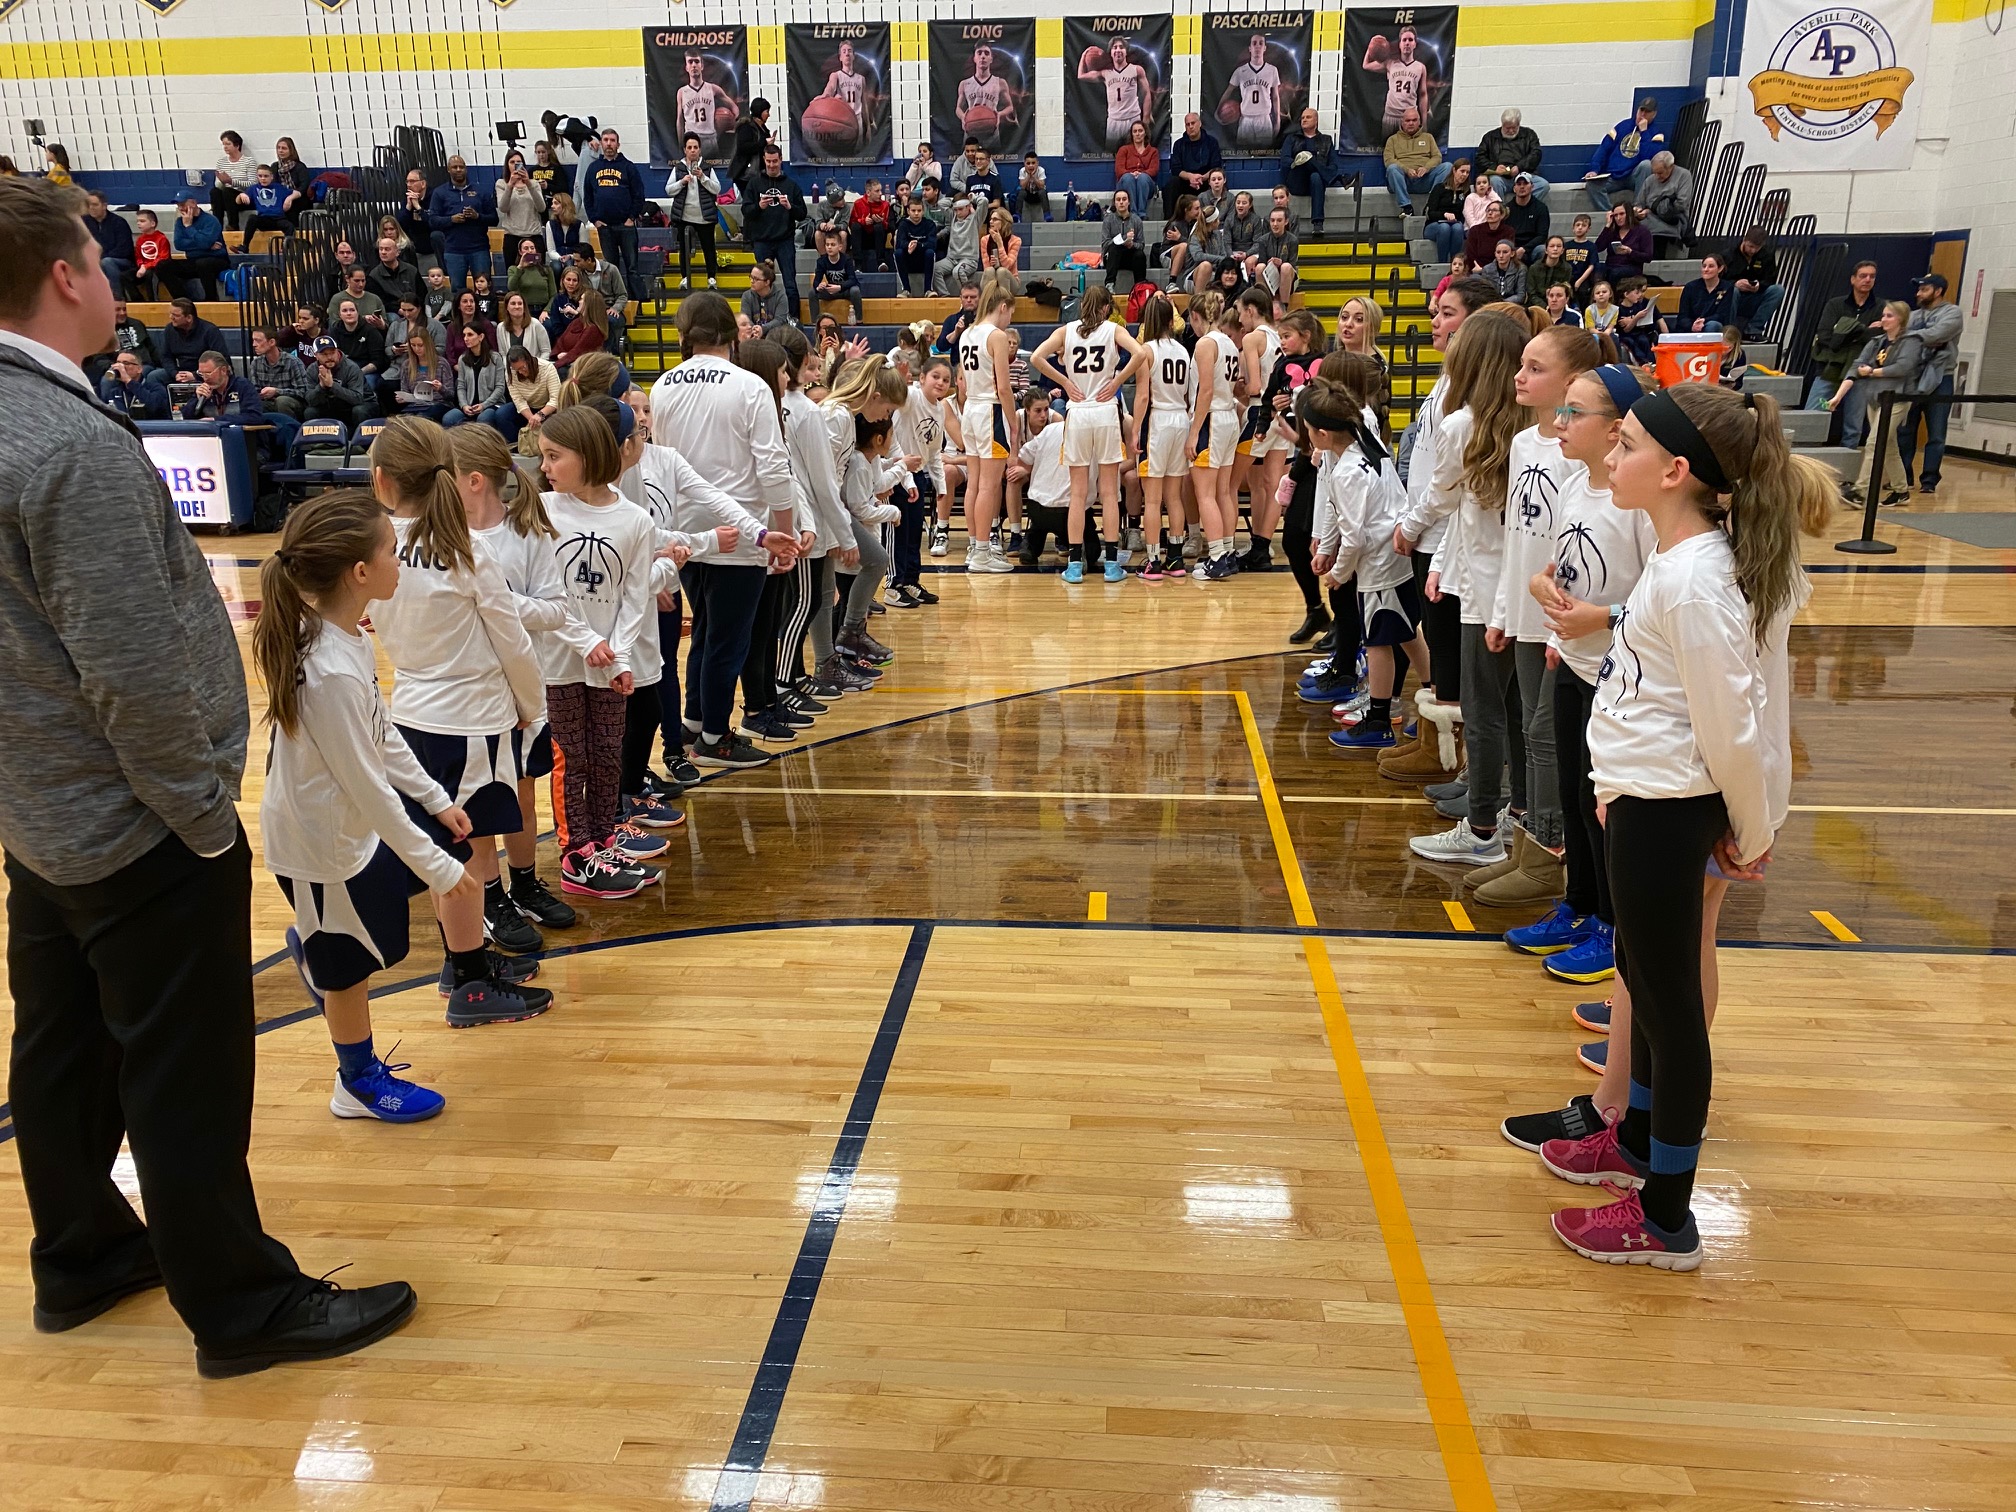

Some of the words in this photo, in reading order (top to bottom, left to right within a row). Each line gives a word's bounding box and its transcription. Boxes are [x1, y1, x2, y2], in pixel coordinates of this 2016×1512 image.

[1092, 17, 1143, 31] MORIN
[1212, 13, 1304, 28] PASCARELLA
[1394, 10, 1414, 24] RE
[813, 25, 867, 38] LETTKO
[962, 25, 1003, 39] LONG
[1794, 12, 1841, 38] AVERILL
[1849, 12, 1878, 35] PARK
[655, 31, 734, 46] CHILDROSE
[1810, 28, 1856, 76] AP
[1395, 80, 1411, 93] 24
[1786, 78, 1796, 87] the
[846, 90, 856, 103] 11
[1116, 87, 1121, 101] 1
[1252, 90, 1259, 104] 0
[1791, 90, 1800, 98] for
[1802, 94, 1817, 102] every
[1841, 94, 1857, 102] every
[1859, 90, 1870, 98] day
[694, 107, 706, 122] 13
[1777, 106, 1806, 132] CENTRAL
[1807, 127, 1838, 136] SCHOOL
[1840, 105, 1875, 132] DISTRICT
[961, 345, 979, 370] 25
[1072, 346, 1106, 373] 23
[1162, 358, 1187, 385] 00
[1224, 355, 1239, 381] 32
[1689, 356, 1708, 377] G
[664, 369, 730, 386] BOGART
[302, 425, 340, 436] WARRIORS
[574, 560, 605, 594] AP
